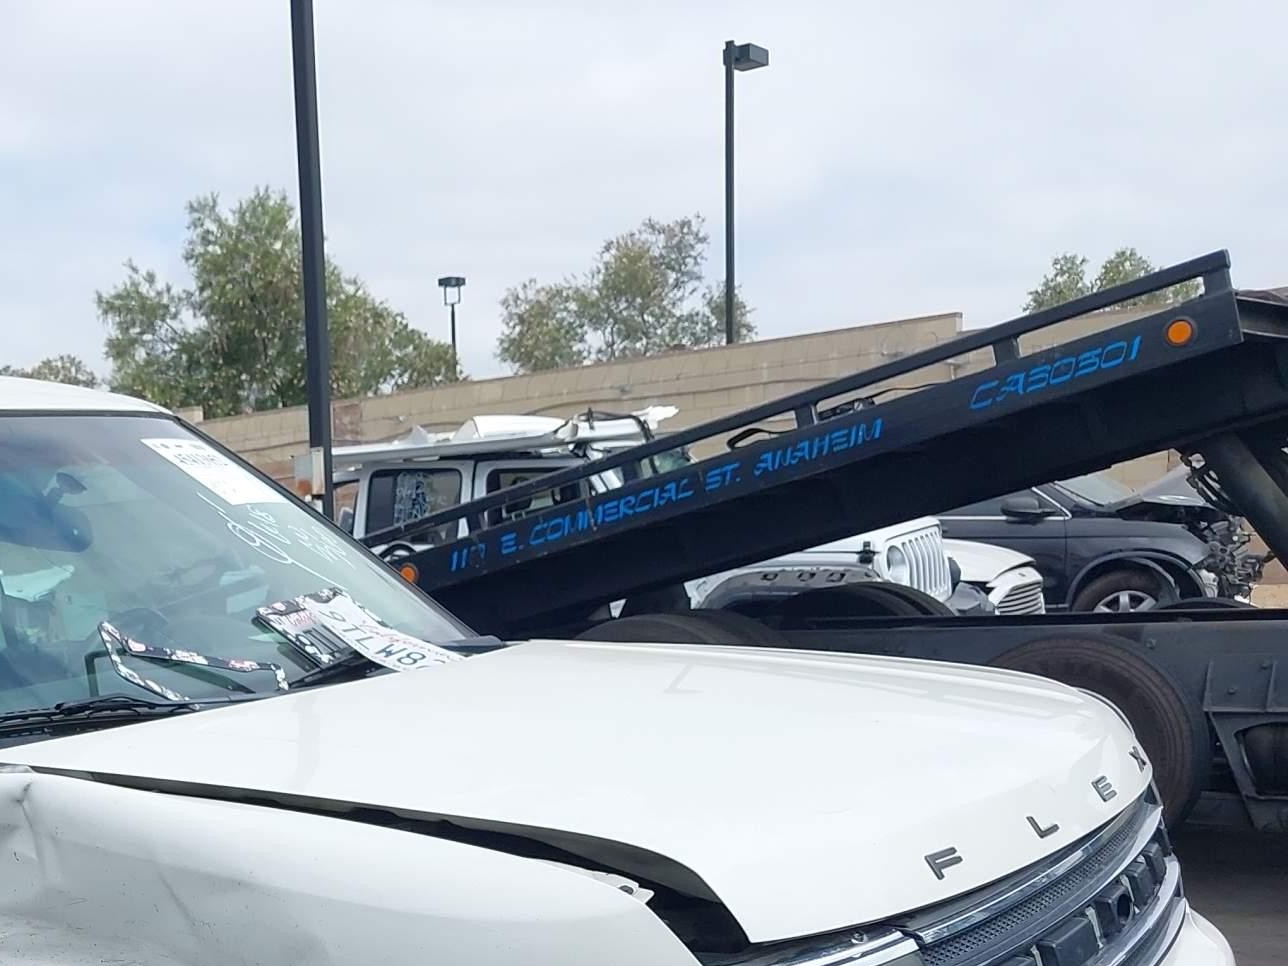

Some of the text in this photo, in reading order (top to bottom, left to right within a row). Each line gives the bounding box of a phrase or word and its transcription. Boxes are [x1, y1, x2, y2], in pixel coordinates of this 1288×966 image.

[528, 478, 694, 546] COMMERCIAL
[705, 462, 742, 491] ST.
[753, 417, 884, 477] ANAHEIM
[924, 746, 1147, 880] FLEX
